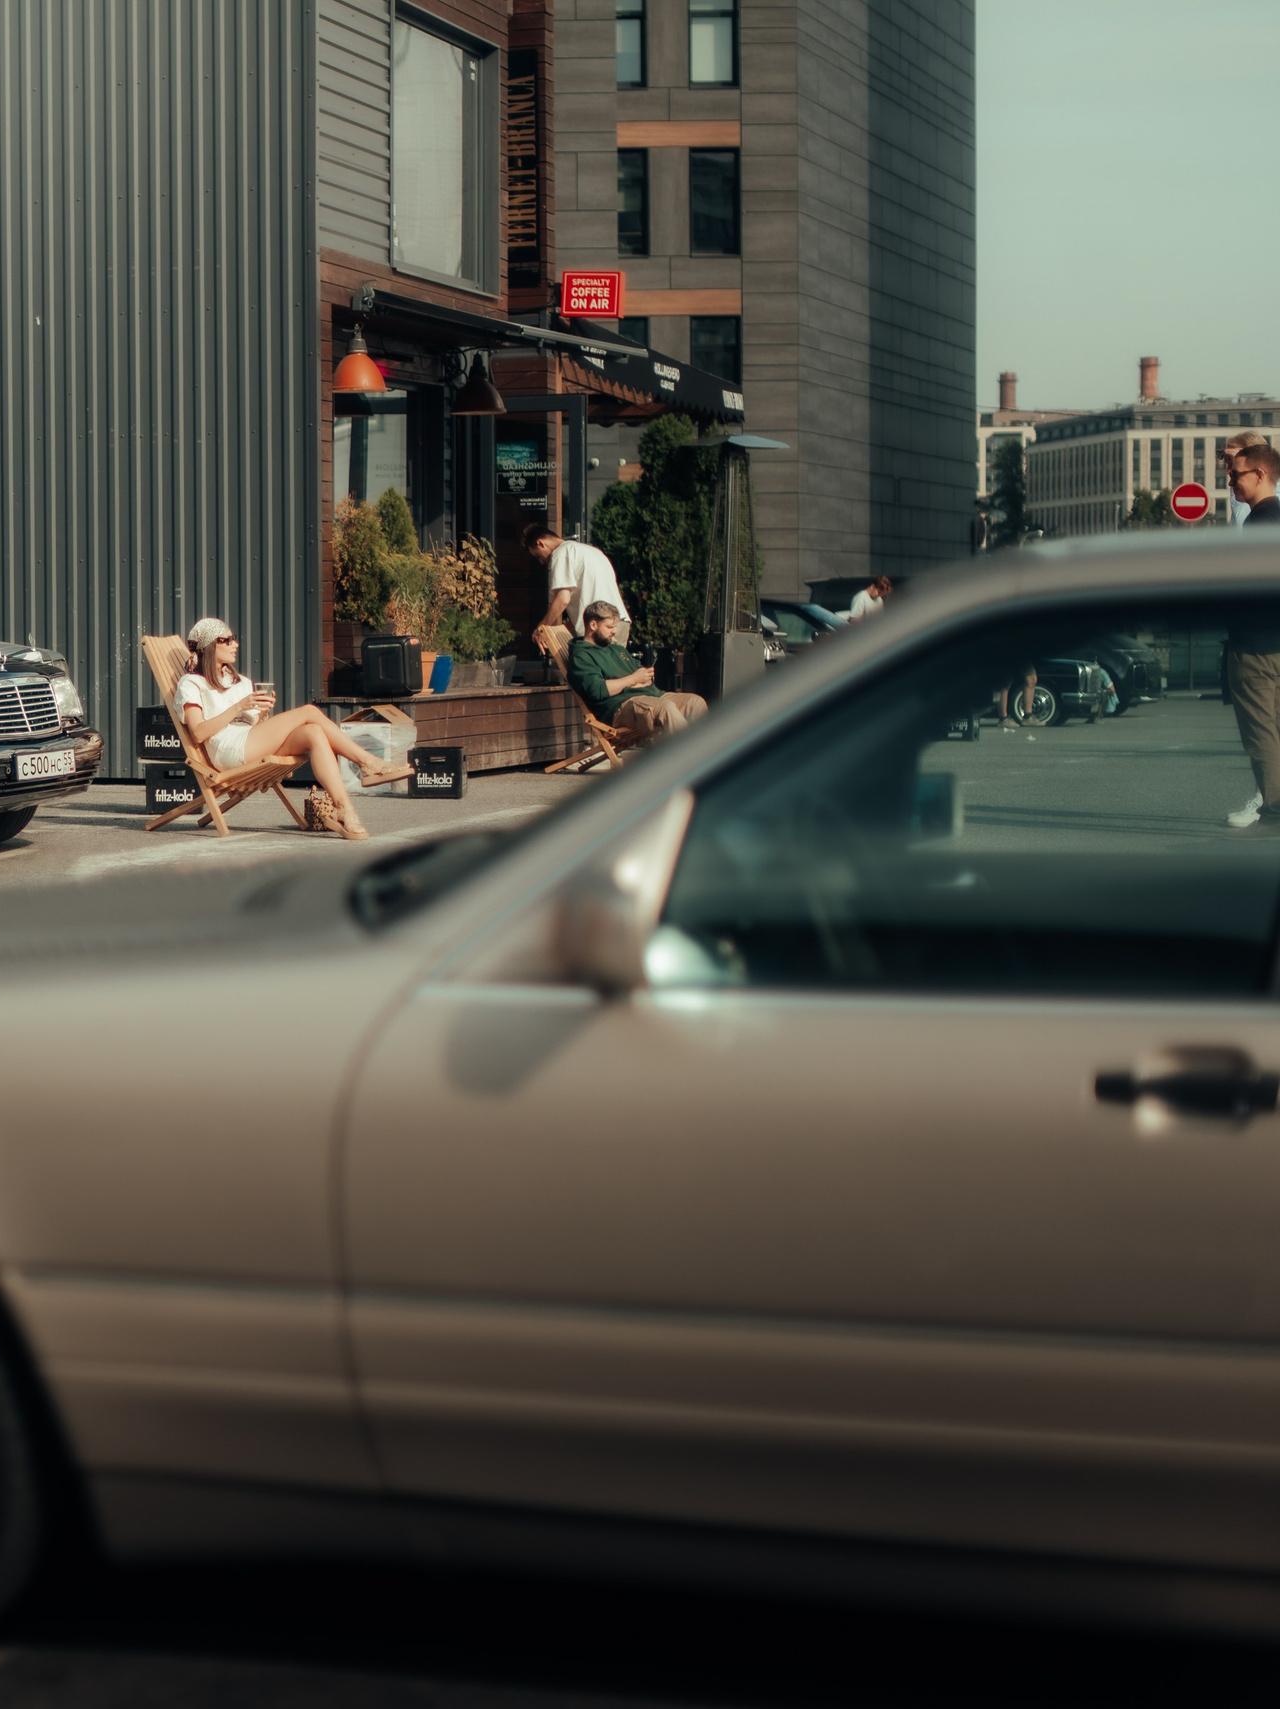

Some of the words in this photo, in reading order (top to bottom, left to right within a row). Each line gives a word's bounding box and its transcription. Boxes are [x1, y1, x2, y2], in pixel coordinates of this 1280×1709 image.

[507, 74, 537, 248] FERNET-BRANCA
[572, 278, 610, 286] SPECIALTY
[571, 287, 610, 297] COFFEE
[570, 298, 587, 309] ON
[589, 298, 609, 309] AIR
[144, 735, 180, 747] fritz-kola
[63, 752, 72, 766] 55
[417, 773, 453, 785] fritz-kola
[155, 789, 194, 802] fritz-kola
